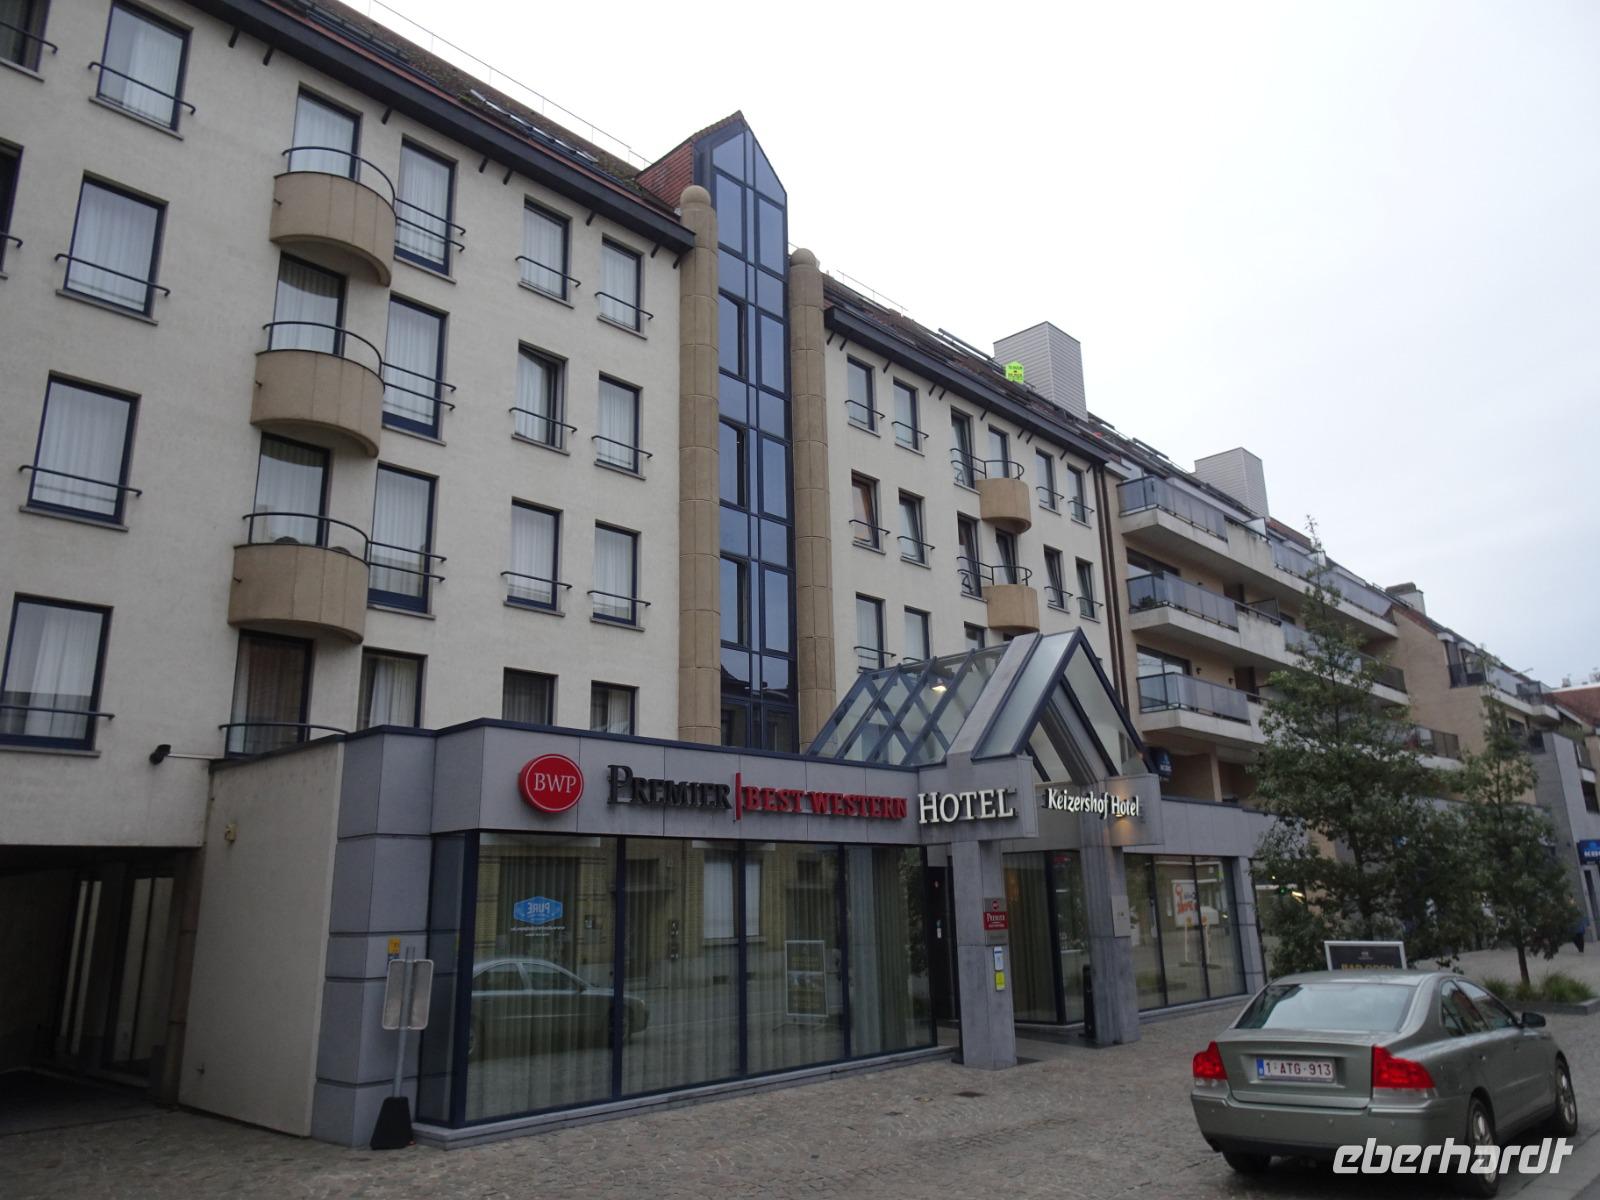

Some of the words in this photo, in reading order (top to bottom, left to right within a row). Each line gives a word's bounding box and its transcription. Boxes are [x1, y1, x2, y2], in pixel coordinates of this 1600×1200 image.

[533, 772, 577, 794] BWP
[607, 764, 732, 810] PREMIER
[743, 785, 805, 813] BEST
[807, 791, 908, 820] WESTERN
[918, 787, 1015, 824] HOTEL
[1047, 787, 1110, 820] Keizershof
[1111, 795, 1139, 817] Hotel
